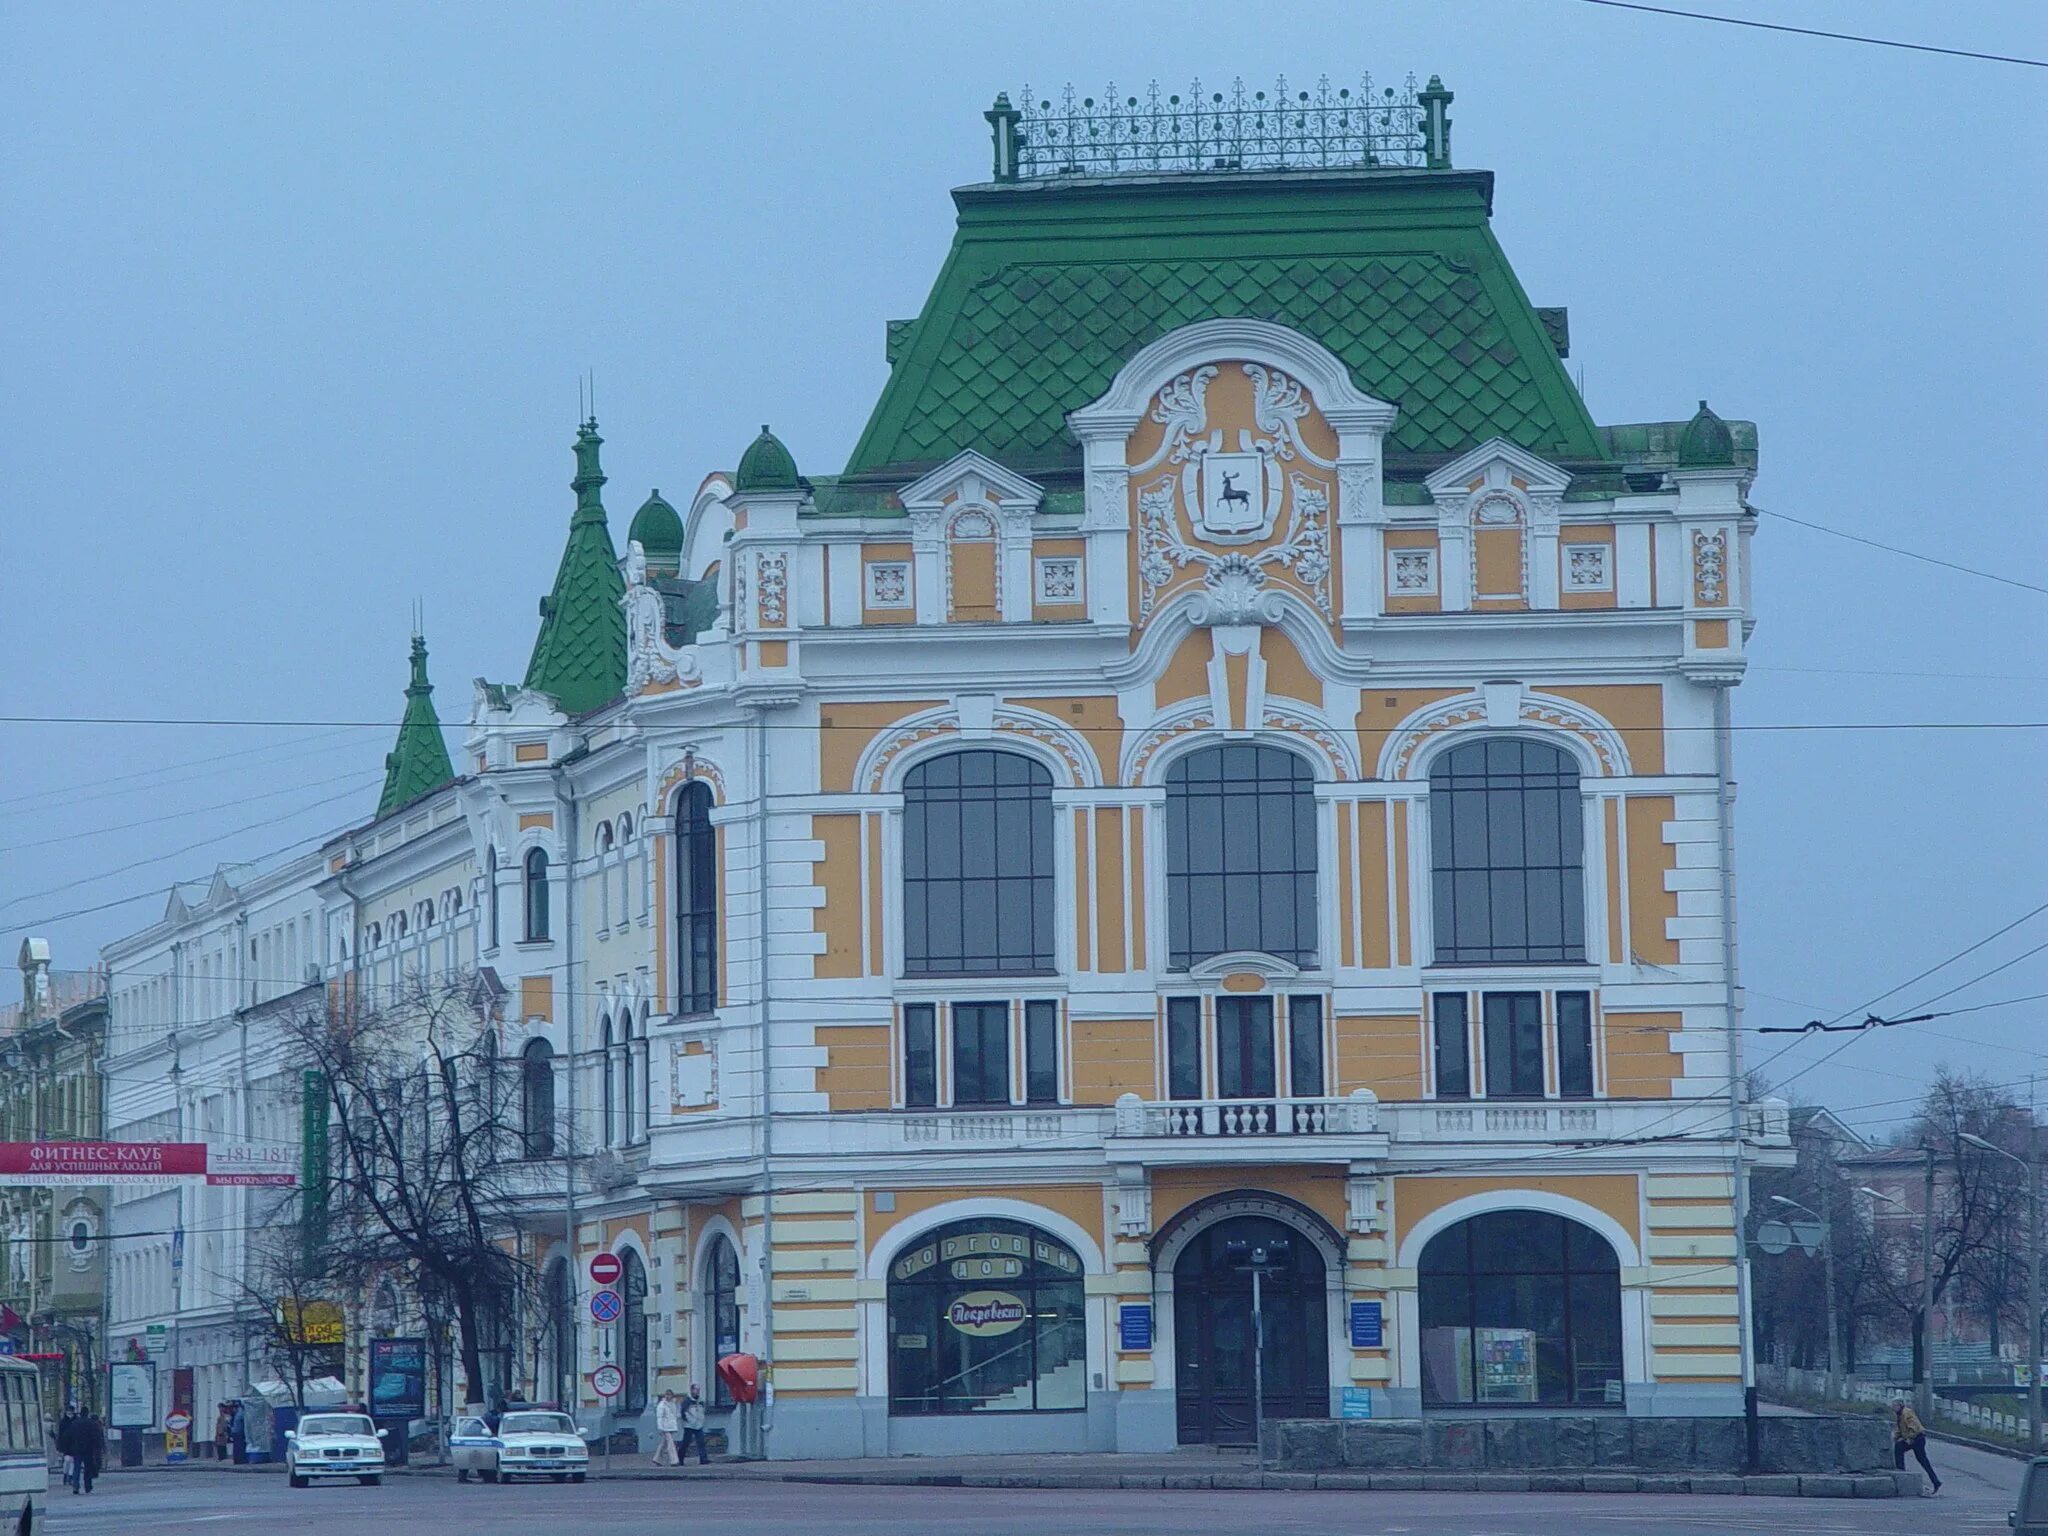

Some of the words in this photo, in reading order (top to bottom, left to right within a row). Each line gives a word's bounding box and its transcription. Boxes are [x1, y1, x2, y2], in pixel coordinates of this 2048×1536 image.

[30, 1147, 162, 1161] ФИТНЕС-КЛУБ
[29, 1162, 50, 1171] ДЛЯ
[54, 1161, 120, 1171] УСПЕШНЫХ
[121, 1161, 162, 1171] ЛЮДЕЙ
[10, 1175, 94, 1185] СПЕЦИАЛЬНОЕ
[97, 1175, 181, 1185] ПРЕДЛОЖЕНИЕ
[958, 1259, 1018, 1278] ДОМ
[953, 1300, 1022, 1325] Покровский
